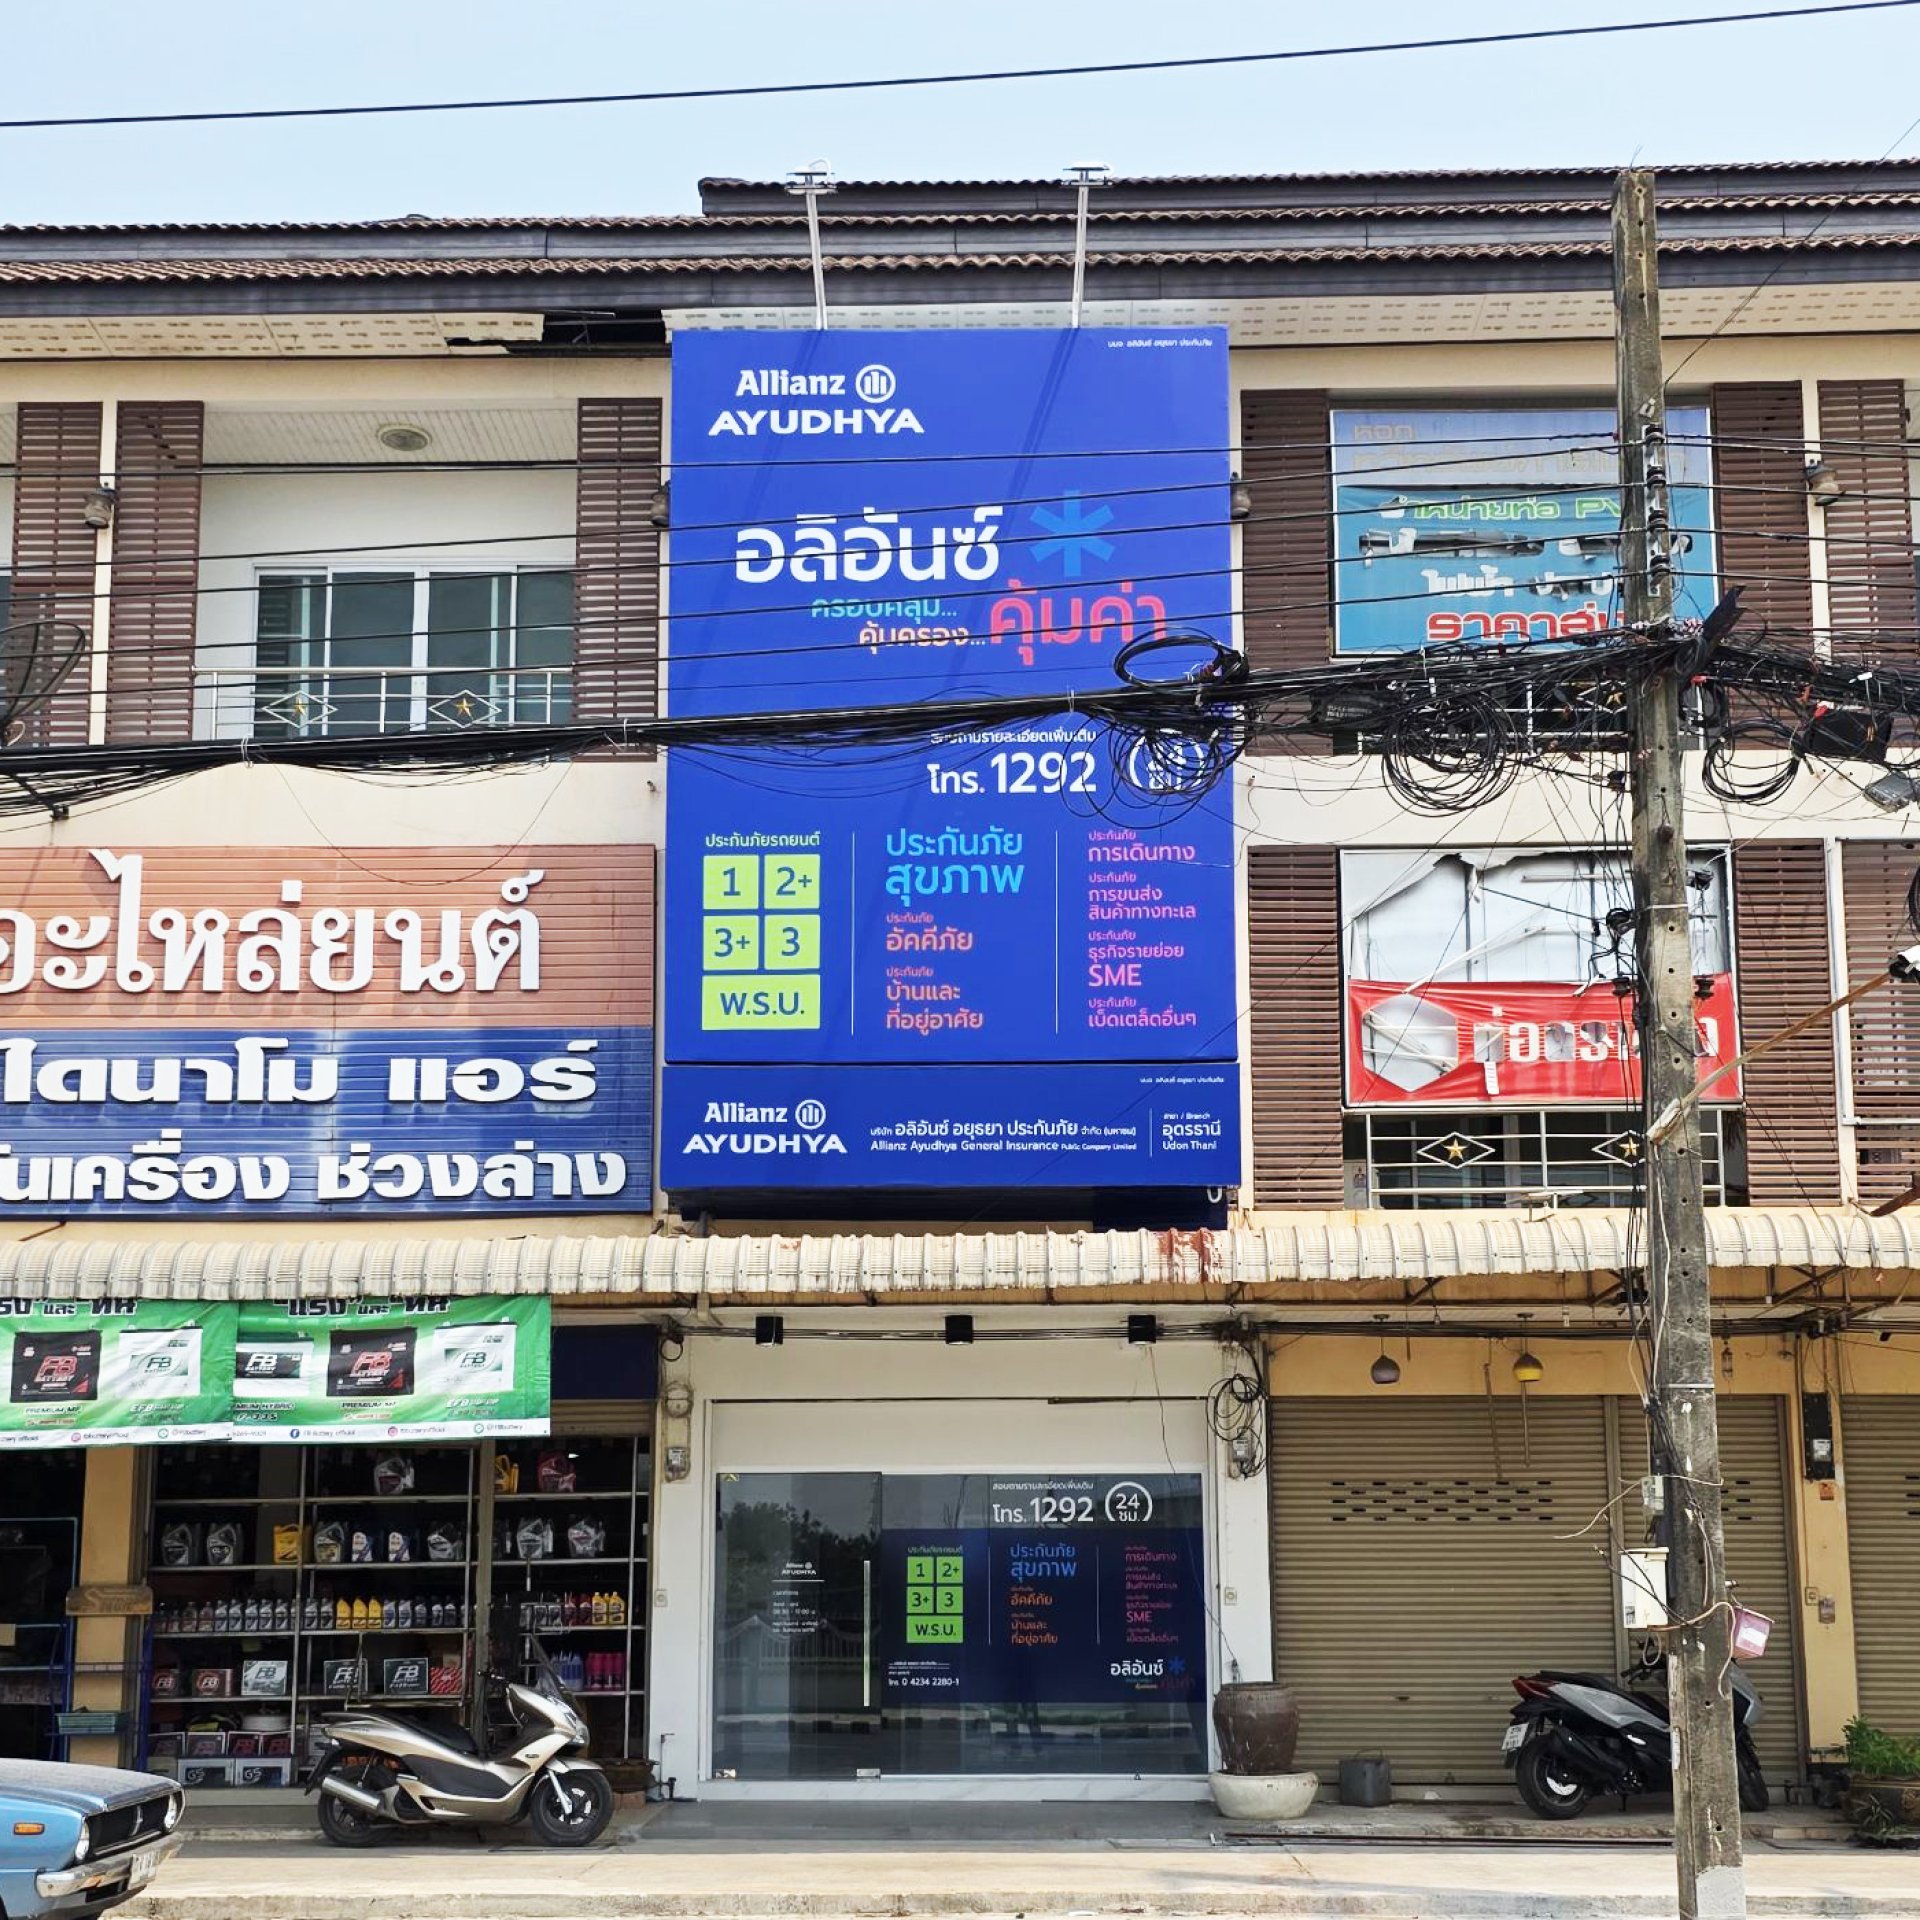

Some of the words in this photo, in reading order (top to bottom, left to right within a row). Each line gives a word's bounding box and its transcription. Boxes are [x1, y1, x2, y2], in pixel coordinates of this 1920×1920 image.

[736, 369, 845, 396] Allianz
[708, 409, 924, 436] AYUDHYA
[735, 506, 1004, 584] อลิอันซ์
[811, 598, 957, 625] ครอบคลุม...
[989, 579, 1166, 667] คุ้มค่า
[927, 763, 985, 794] โทร.
[991, 751, 1097, 794] 1292
[705, 830, 821, 848] ประกันภัยรถยนต์
[886, 825, 1023, 857] ประกันภัย
[1088, 829, 1136, 841] ประกันภัย
[1088, 842, 1196, 862] การเดินทาง
[722, 866, 741, 897] 1
[775, 866, 813, 896] 2+
[885, 863, 1025, 908] สุขภาพ
[1088, 871, 1136, 883] ประกันภัย
[1088, 883, 1163, 902] การขนส่ง
[886, 912, 934, 924] ประกันภัย
[1088, 902, 1196, 921] สินค้าทางทะเล
[713, 927, 750, 958] 3+
[780, 926, 800, 957] 3
[886, 925, 974, 951] อัคคีภัย
[1088, 930, 1136, 942] ประกันภัย
[1088, 941, 1185, 963] ธุรกิจรายย่อย
[886, 966, 934, 978] ประกันภัย
[1088, 963, 1142, 987] SME
[886, 979, 961, 1001] บ้านและ
[719, 991, 805, 1016] พ.ร.บ.
[1088, 996, 1136, 1008] ประกันภัย
[886, 1002, 984, 1036] ที่อยู่อาศัย
[1088, 1004, 1197, 1028] เบ็ดเตล็ดอื่นๆ
[388, 1037, 599, 1104] แอร์
[704, 1102, 788, 1123] Allianz
[895, 1119, 950, 1136] อลิอันซ์
[952, 1122, 1003, 1140] อยุธยา
[1007, 1118, 1078, 1136] ประกันภัย
[1162, 1118, 1222, 1141] อุดรธานี
[682, 1134, 848, 1154] AYUDHYA
[870, 1139, 908, 1151] Allianz
[910, 1139, 957, 1153] Ayudhya
[960, 1139, 1003, 1151] General
[1006, 1139, 1060, 1151] Insurance
[1162, 1140, 1189, 1150] Udon
[1190, 1140, 1217, 1150] Thani
[0, 1128, 289, 1202] นเครื่อง
[318, 1139, 627, 1199] ช่วงล่าง
[37, 1355, 78, 1377] FB
[146, 1356, 172, 1369] FB
[247, 1353, 278, 1366] FB
[353, 1351, 393, 1371] FB
[461, 1351, 487, 1364] FB
[992, 1503, 1027, 1523] โทร.
[1030, 1497, 1094, 1523] 1292
[1115, 1493, 1140, 1510] 24
[1118, 1510, 1141, 1522] ชม.
[1010, 1542, 1076, 1558] ประกันภัย
[916, 1562, 925, 1578] 1
[942, 1562, 960, 1578] 2+
[1010, 1561, 1078, 1584] สุขภาพ
[911, 1591, 930, 1607] 3+
[944, 1591, 954, 1607] 3
[1126, 1610, 1153, 1623] SME
[255, 1666, 277, 1680] FB
[392, 1664, 420, 1681] FB
[1110, 1658, 1164, 1676] อลิอันซ์
[187, 1768, 206, 1780] GS
[244, 1767, 263, 1780] GS
